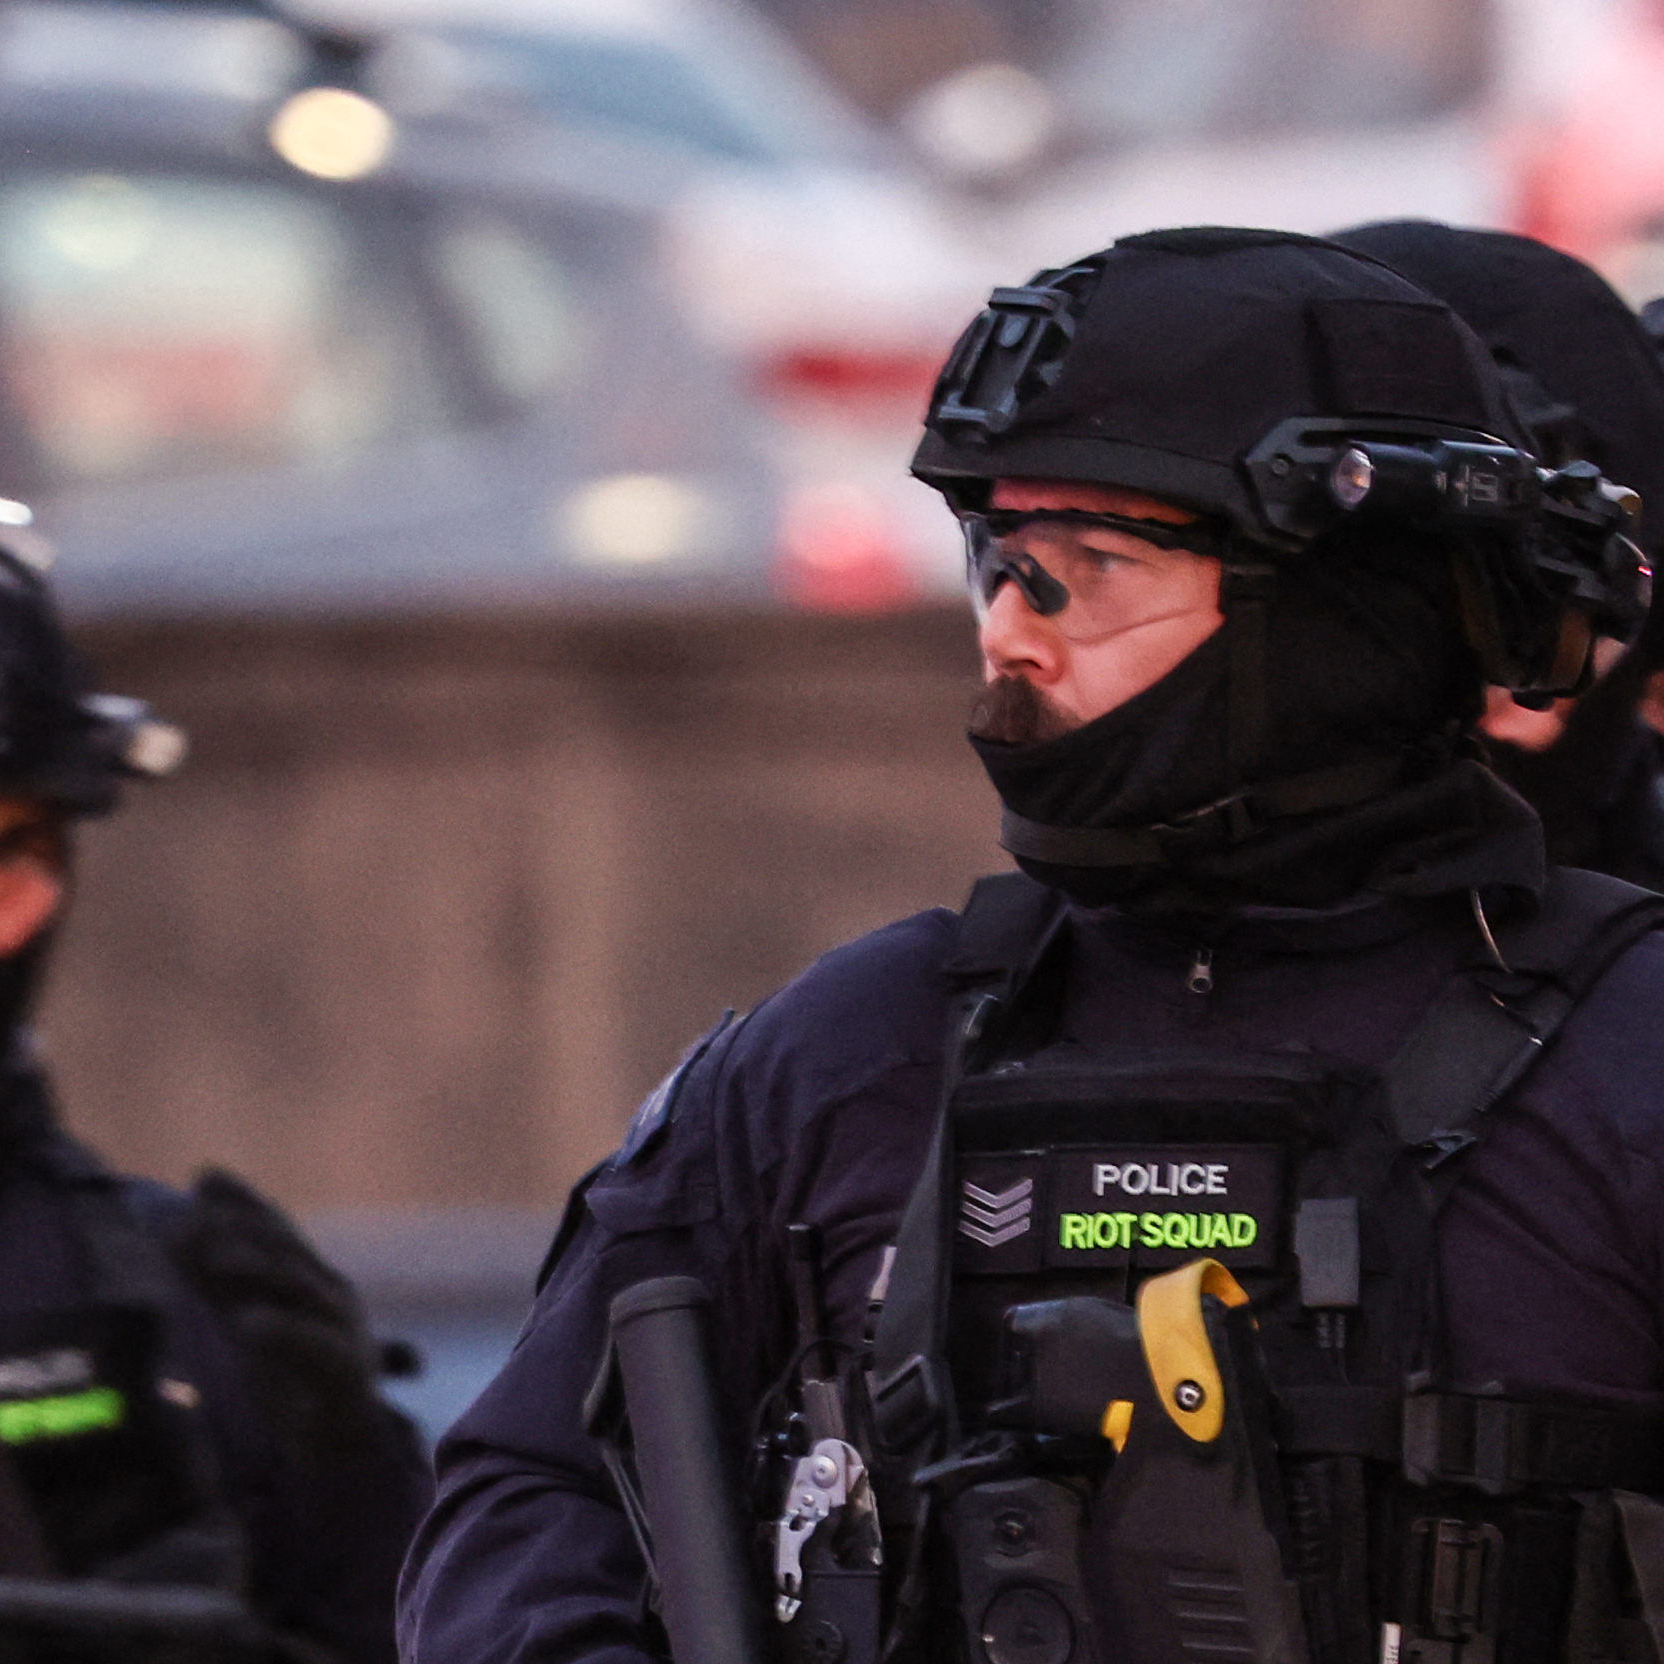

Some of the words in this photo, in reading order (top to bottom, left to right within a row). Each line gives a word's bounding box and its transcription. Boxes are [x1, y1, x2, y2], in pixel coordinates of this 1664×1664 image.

[1094, 1163, 1228, 1196] POLICE
[1060, 1212, 1138, 1249] RIOT
[1140, 1212, 1257, 1249] SQUAD
